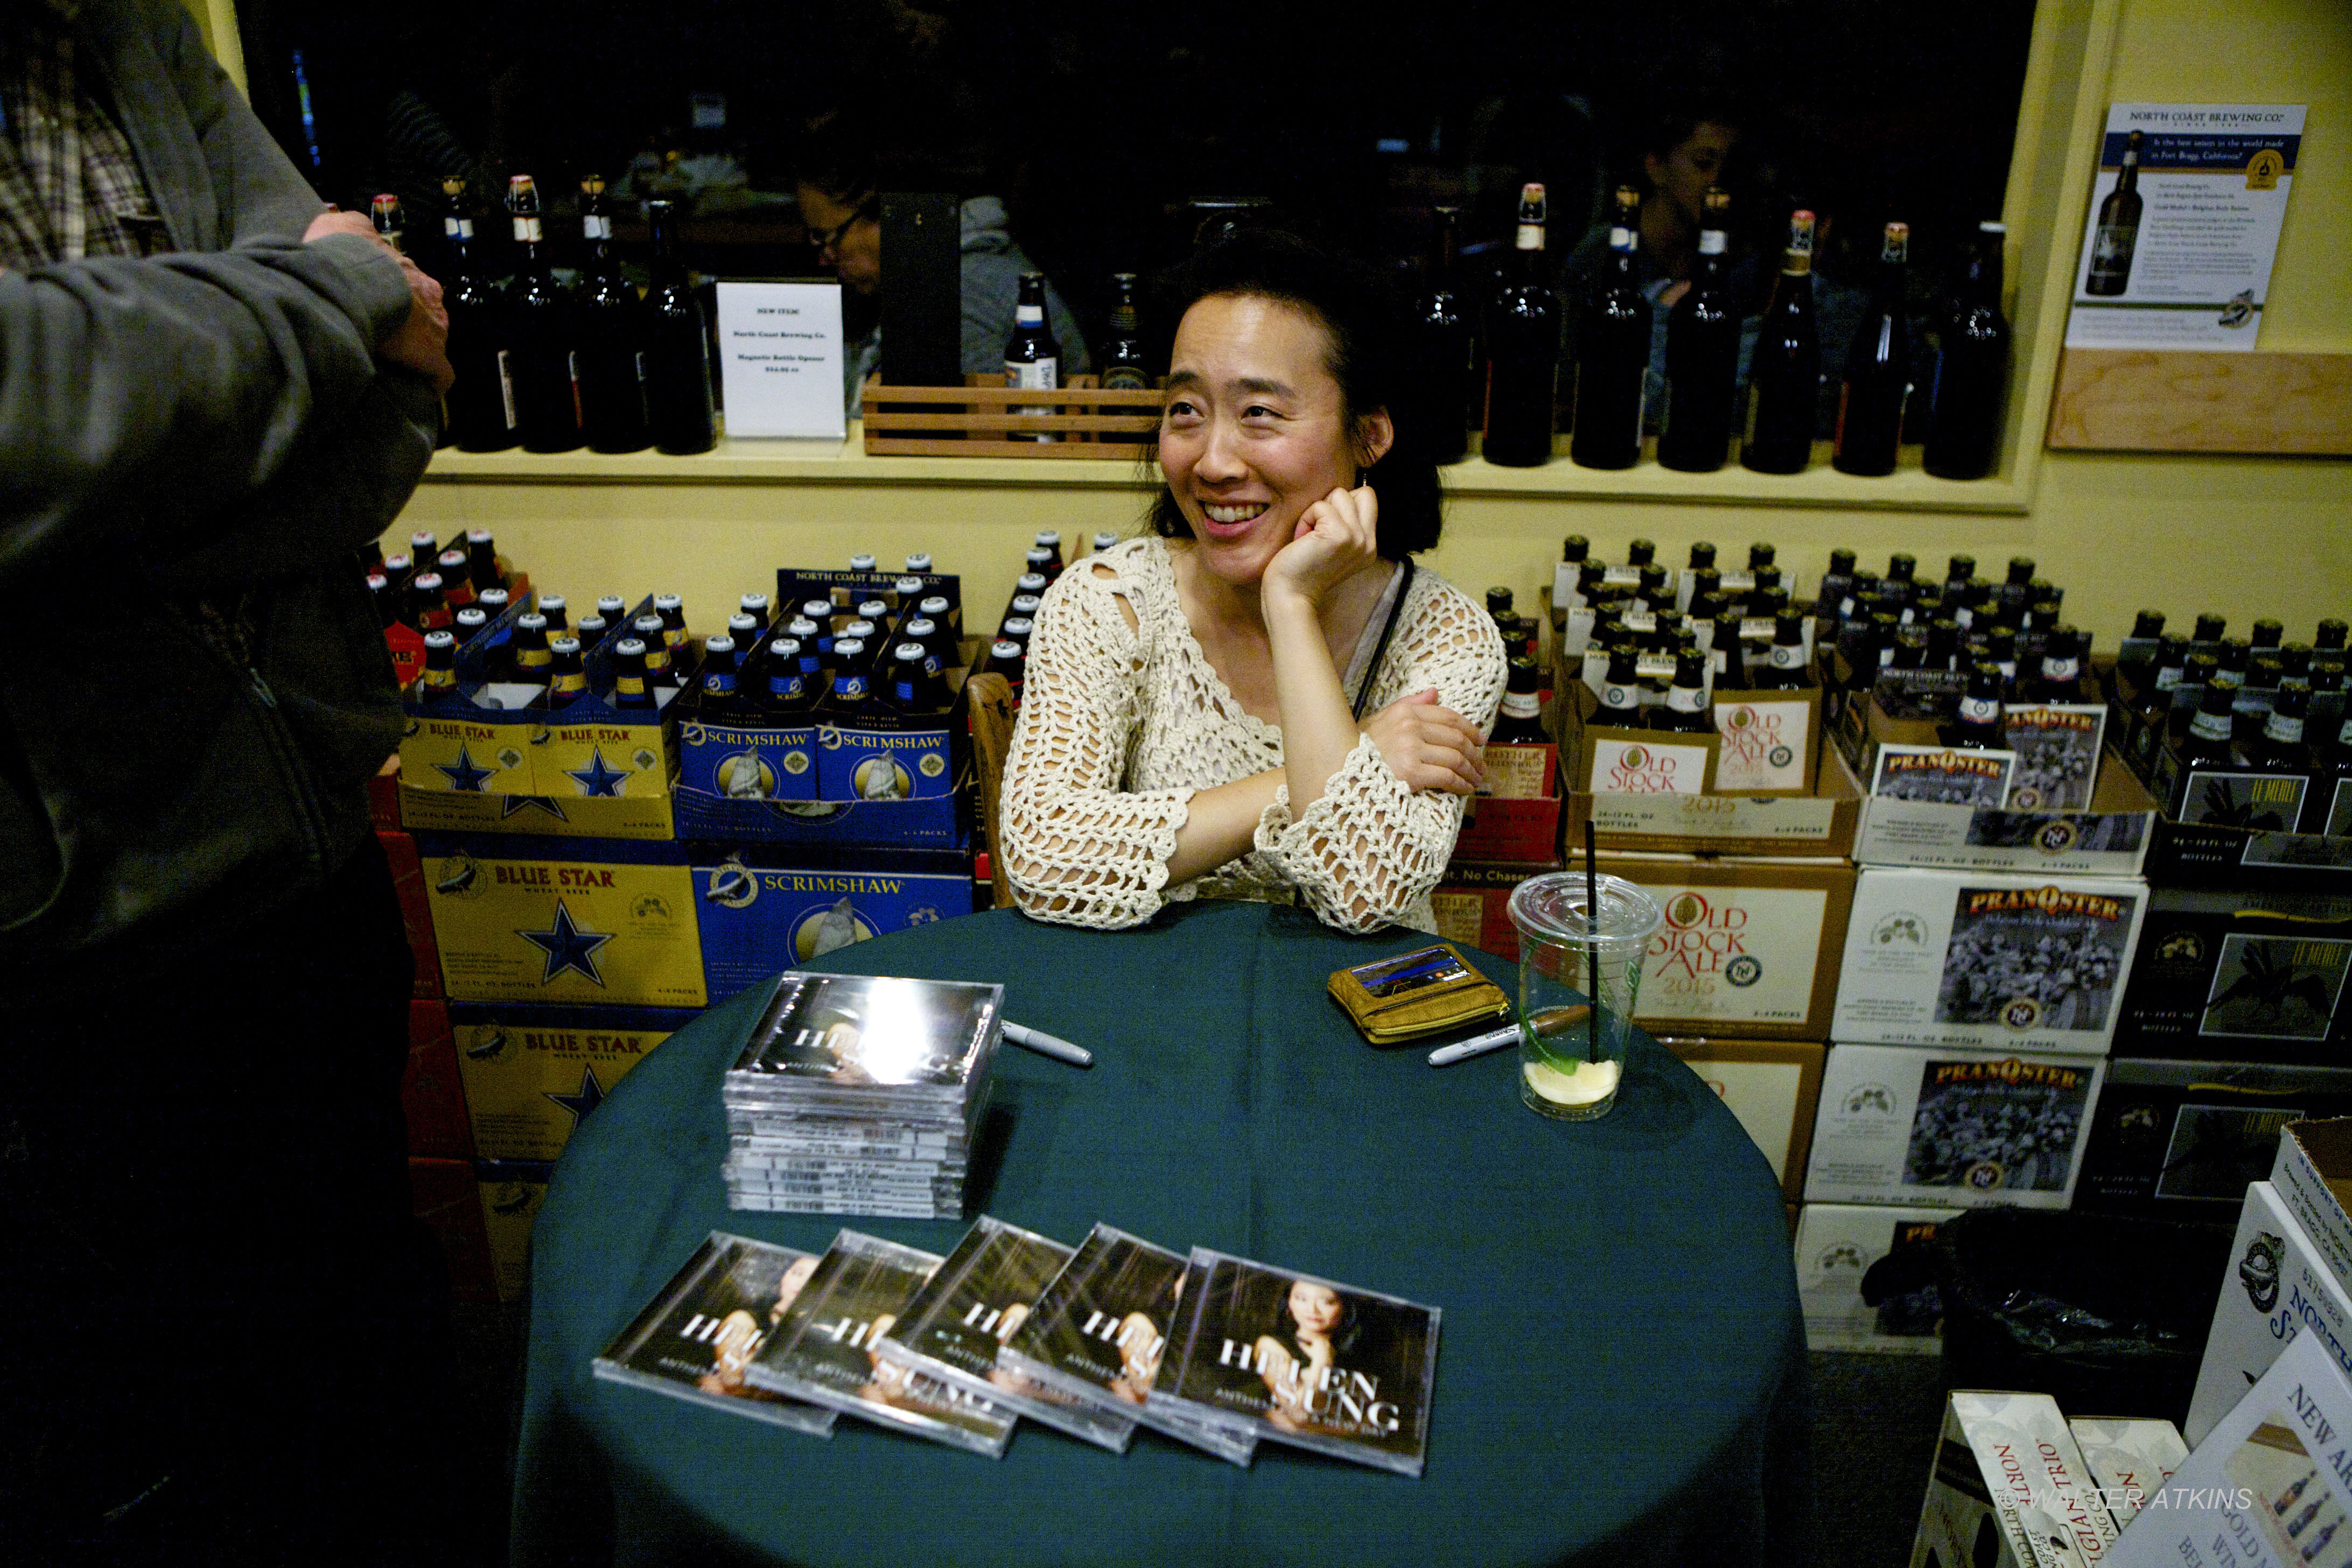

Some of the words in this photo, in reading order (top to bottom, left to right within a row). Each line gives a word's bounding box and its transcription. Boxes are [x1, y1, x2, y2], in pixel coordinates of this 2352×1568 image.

[2130, 112, 2168, 121] NORTH
[2172, 112, 2207, 121] COAST
[2209, 113, 2262, 122] BREWING
[2264, 139, 2284, 148] made
[796, 572, 832, 582] NORTH
[834, 572, 866, 583] COAST
[430, 724, 461, 736] BLUE
[465, 727, 495, 740] STAR
[561, 730, 593, 741] BLUE
[599, 730, 629, 740] STAR
[708, 730, 807, 746] SCRIMSHAW
[843, 734, 942, 749] SCRIMSHAW
[1620, 744, 1676, 772] OLD
[1608, 766, 1675, 790] STOCK
[495, 866, 551, 885] BLUE
[558, 869, 615, 888] STAR
[765, 875, 901, 894] SCRIMSHAW
[1463, 870, 1482, 881] No
[1486, 870, 1532, 883] Chaser
[1664, 891, 1747, 930] OLD
[1968, 885, 2119, 922] PRANQSTER
[1648, 929, 1745, 956] STOCK
[1656, 949, 1723, 979] ALE
[1664, 977, 1716, 995] 2015
[524, 1033, 579, 1051] BLUE
[586, 1036, 642, 1054] STAR
[2306, 1165, 2333, 1207] SUPPORT
[1219, 1338, 1380, 1401] HELEN
[1270, 1382, 1400, 1432] SUNG
[2287, 1383, 2336, 1446] NEW
[2221, 1499, 2259, 1558] GOLD
